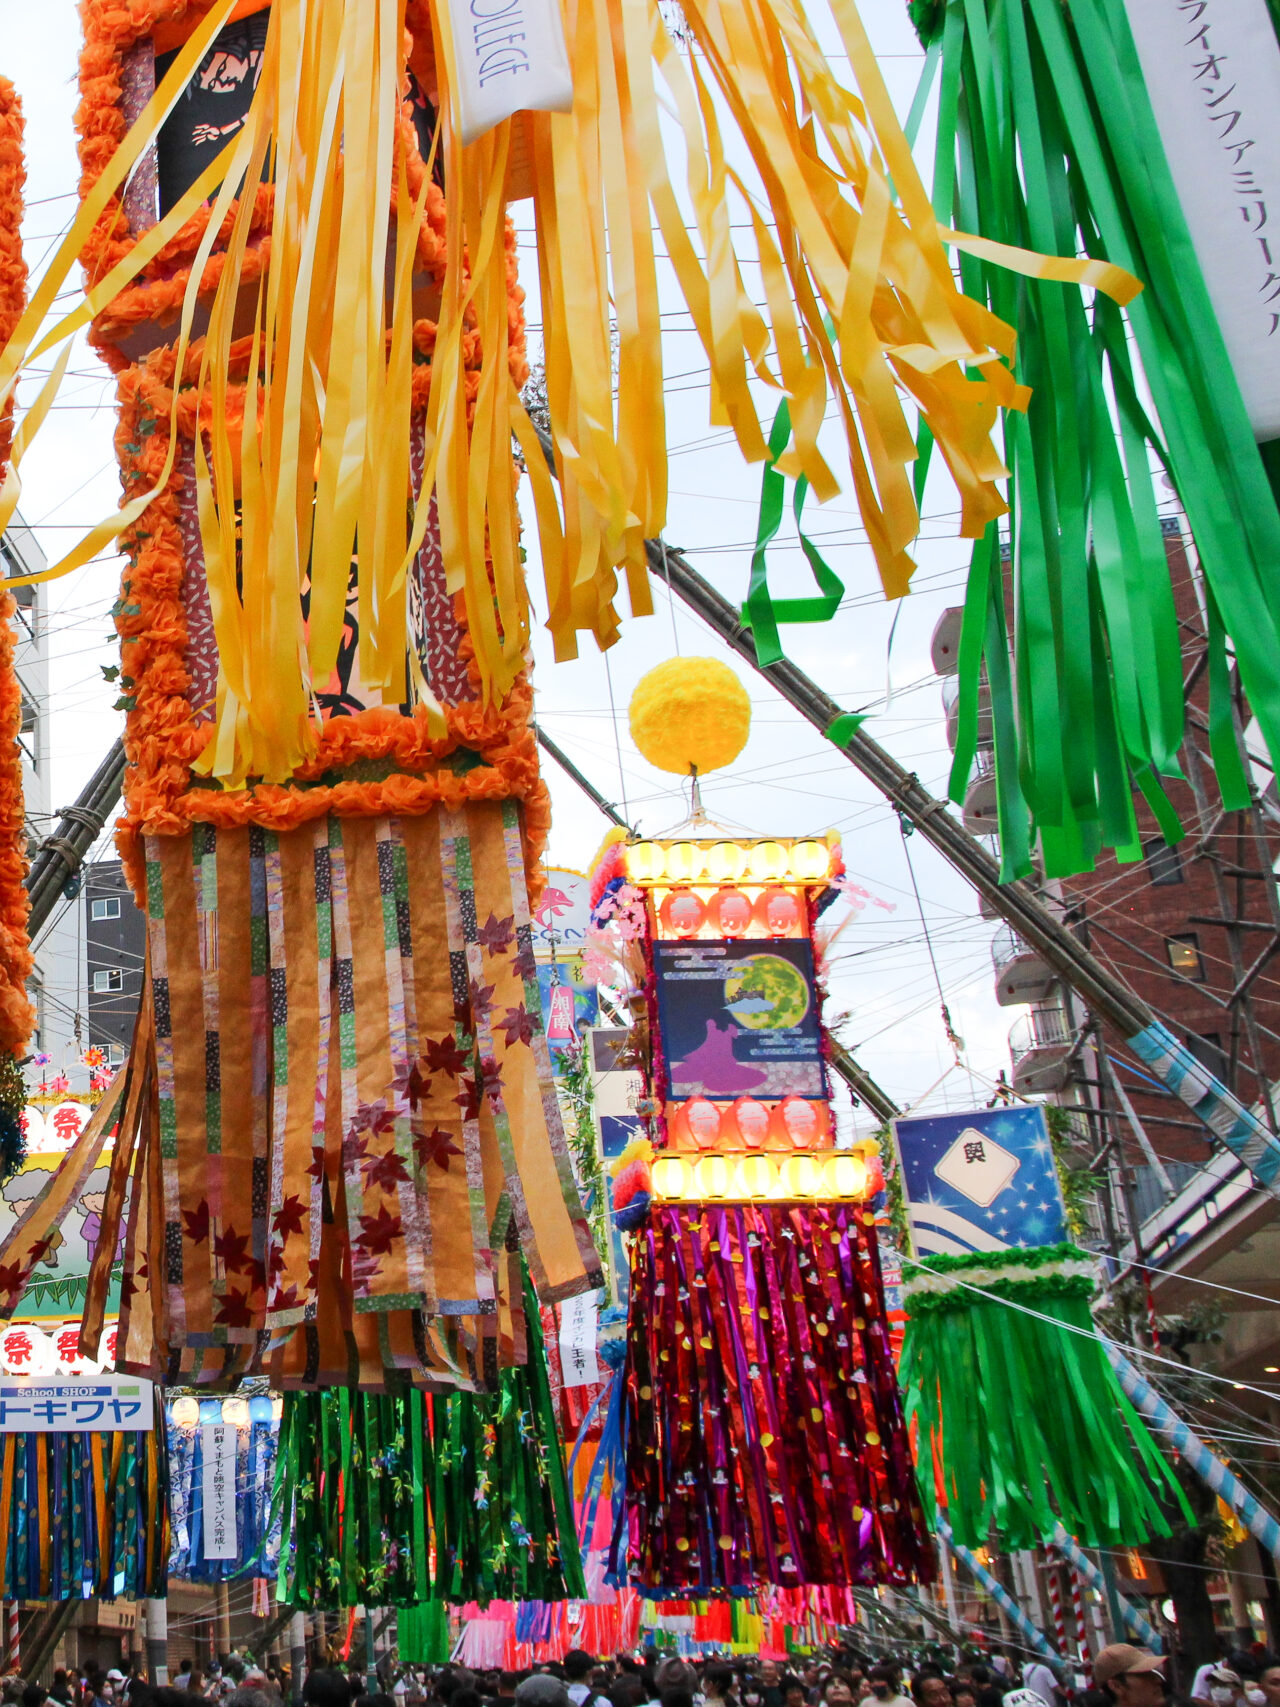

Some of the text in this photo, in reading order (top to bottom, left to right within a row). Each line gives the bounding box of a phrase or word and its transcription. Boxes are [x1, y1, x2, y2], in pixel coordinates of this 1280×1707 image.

[53, 1107, 81, 1140] 祭
[4, 1331, 33, 1366] 祭
[17, 1387, 97, 1397] School SHOP
[0, 1399, 142, 1425] トキワヤ
